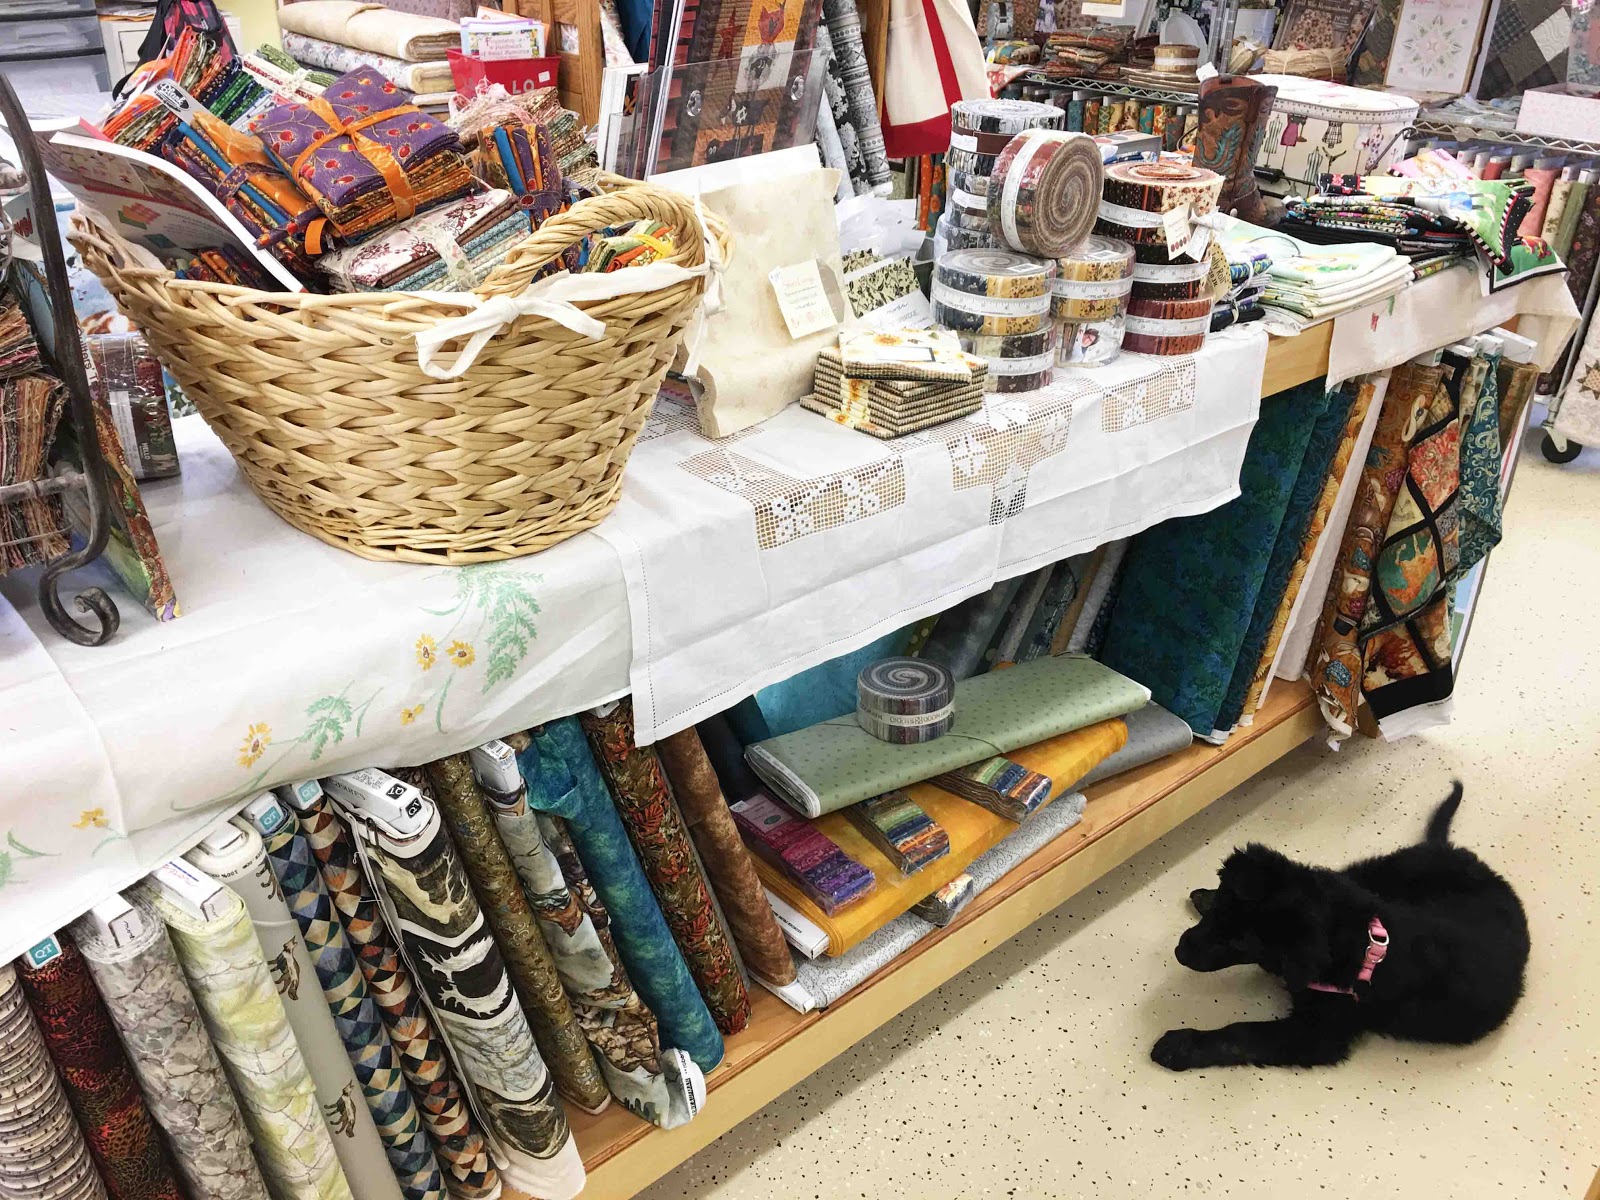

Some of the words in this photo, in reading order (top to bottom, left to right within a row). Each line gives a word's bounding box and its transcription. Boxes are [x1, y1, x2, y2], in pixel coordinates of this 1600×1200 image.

[408, 799, 420, 816] QT
[263, 811, 277, 826] QT
[35, 943, 52, 960] QT
